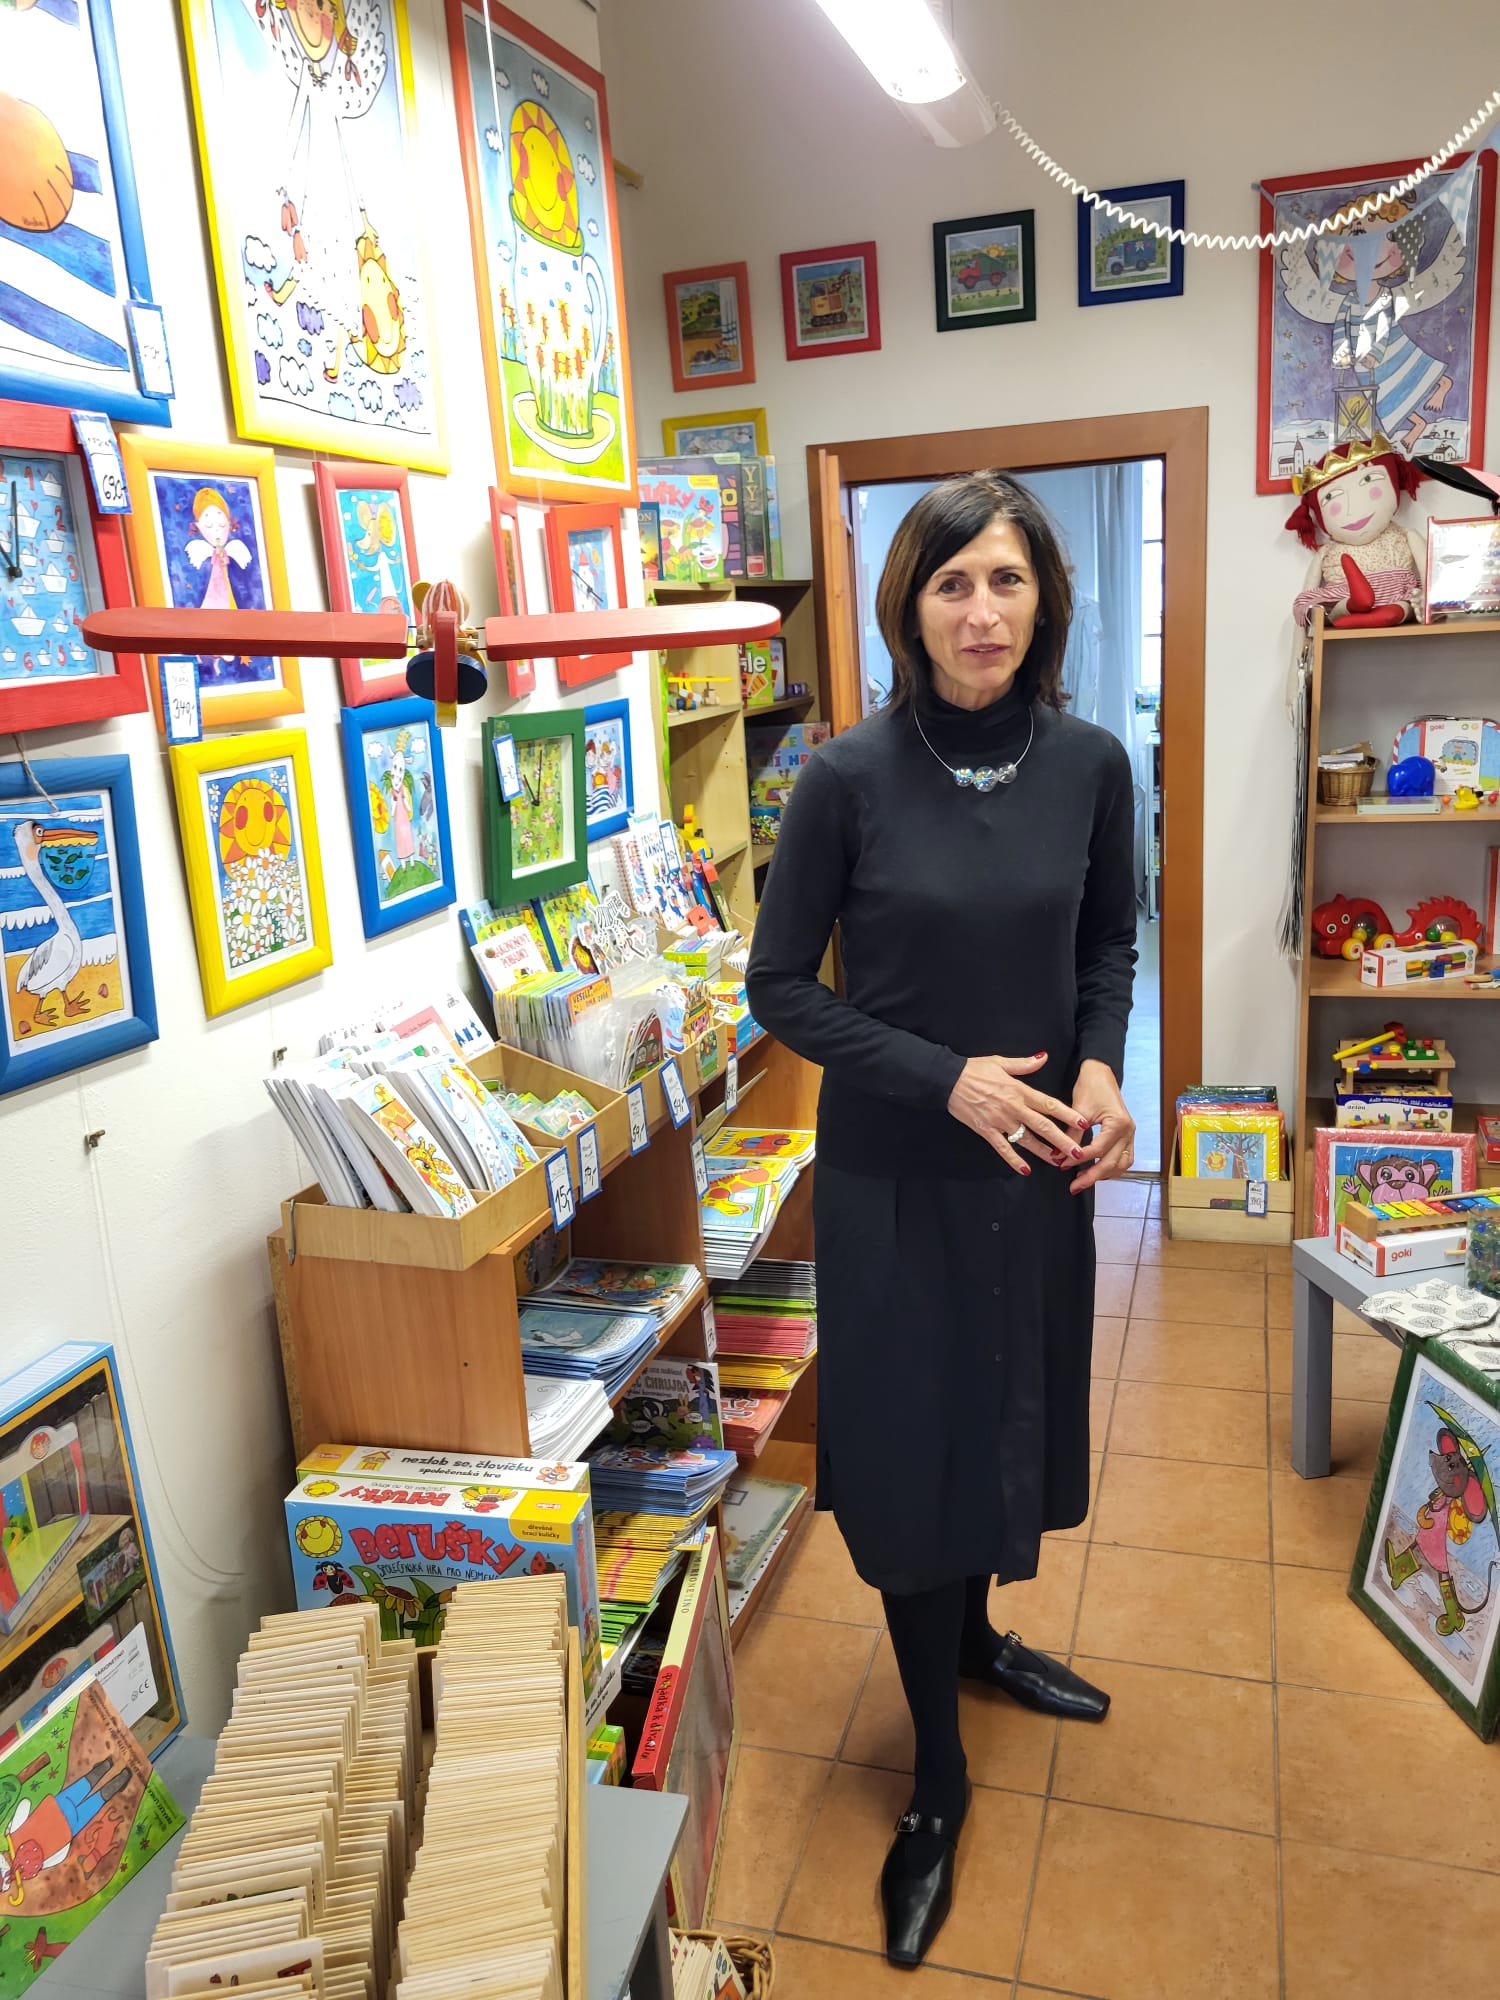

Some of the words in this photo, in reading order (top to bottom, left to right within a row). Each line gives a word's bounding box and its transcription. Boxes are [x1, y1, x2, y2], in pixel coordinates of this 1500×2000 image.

[1391, 1247, 1412, 1262] goki
[400, 1455, 449, 1466] nezlob
[476, 1460, 534, 1473] človíčku
[419, 1467, 480, 1477] společenská
[427, 1564, 441, 1575] HRA
[446, 1566, 462, 1577] PRO
